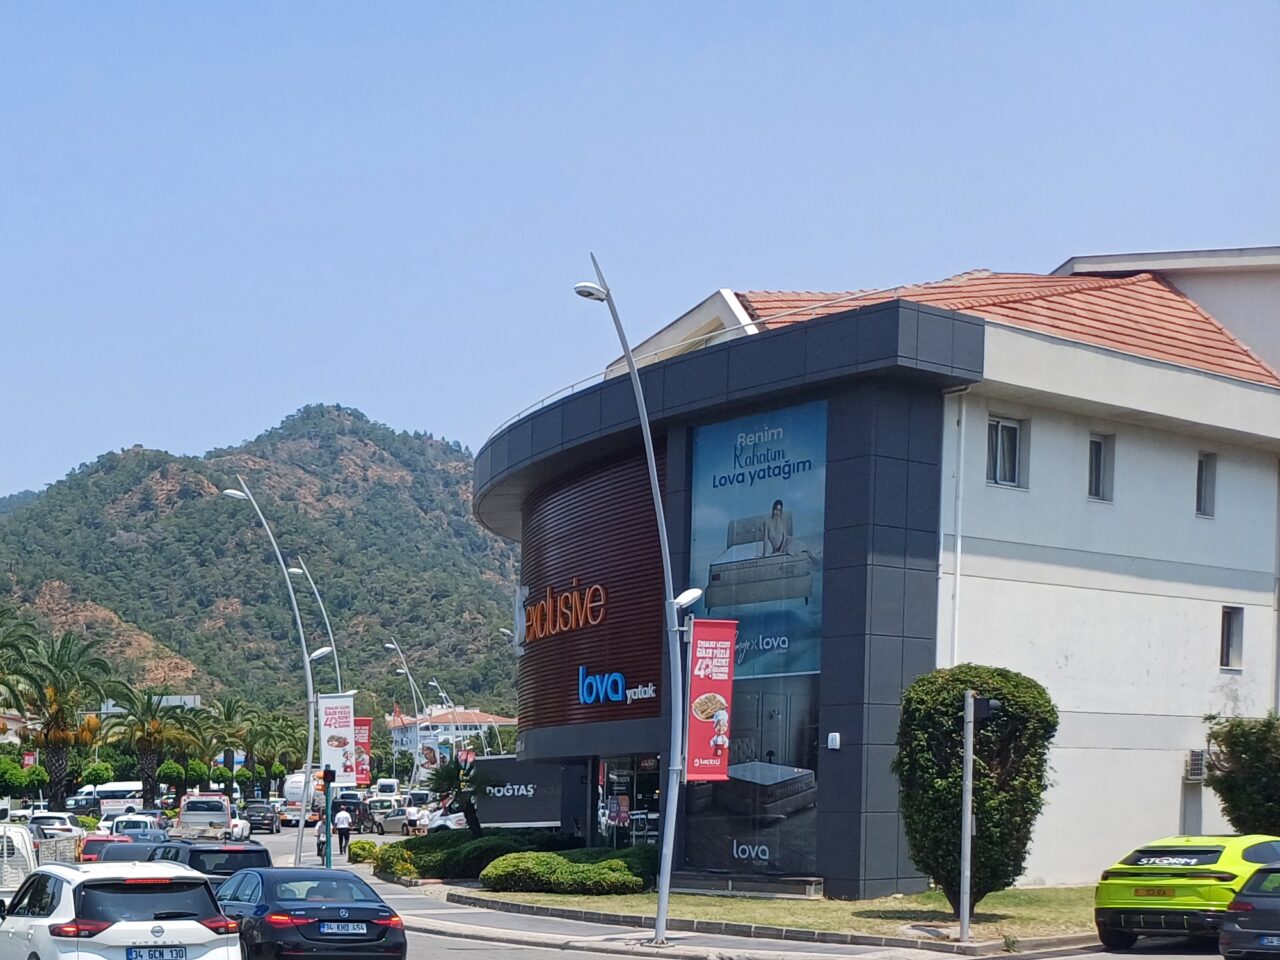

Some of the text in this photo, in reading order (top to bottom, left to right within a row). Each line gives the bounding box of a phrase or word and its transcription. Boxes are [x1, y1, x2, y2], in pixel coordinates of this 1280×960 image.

[737, 427, 783, 448] Benim
[712, 459, 811, 488] Lova yatağım
[525, 578, 608, 642] exclusive
[759, 635, 789, 650] lova
[578, 664, 656, 705] lova yatak
[486, 782, 535, 798] DOĞTAŞ
[733, 839, 770, 860] lova
[1137, 857, 1198, 865] STORM
[132, 948, 184, 960] 34 GCN 130
